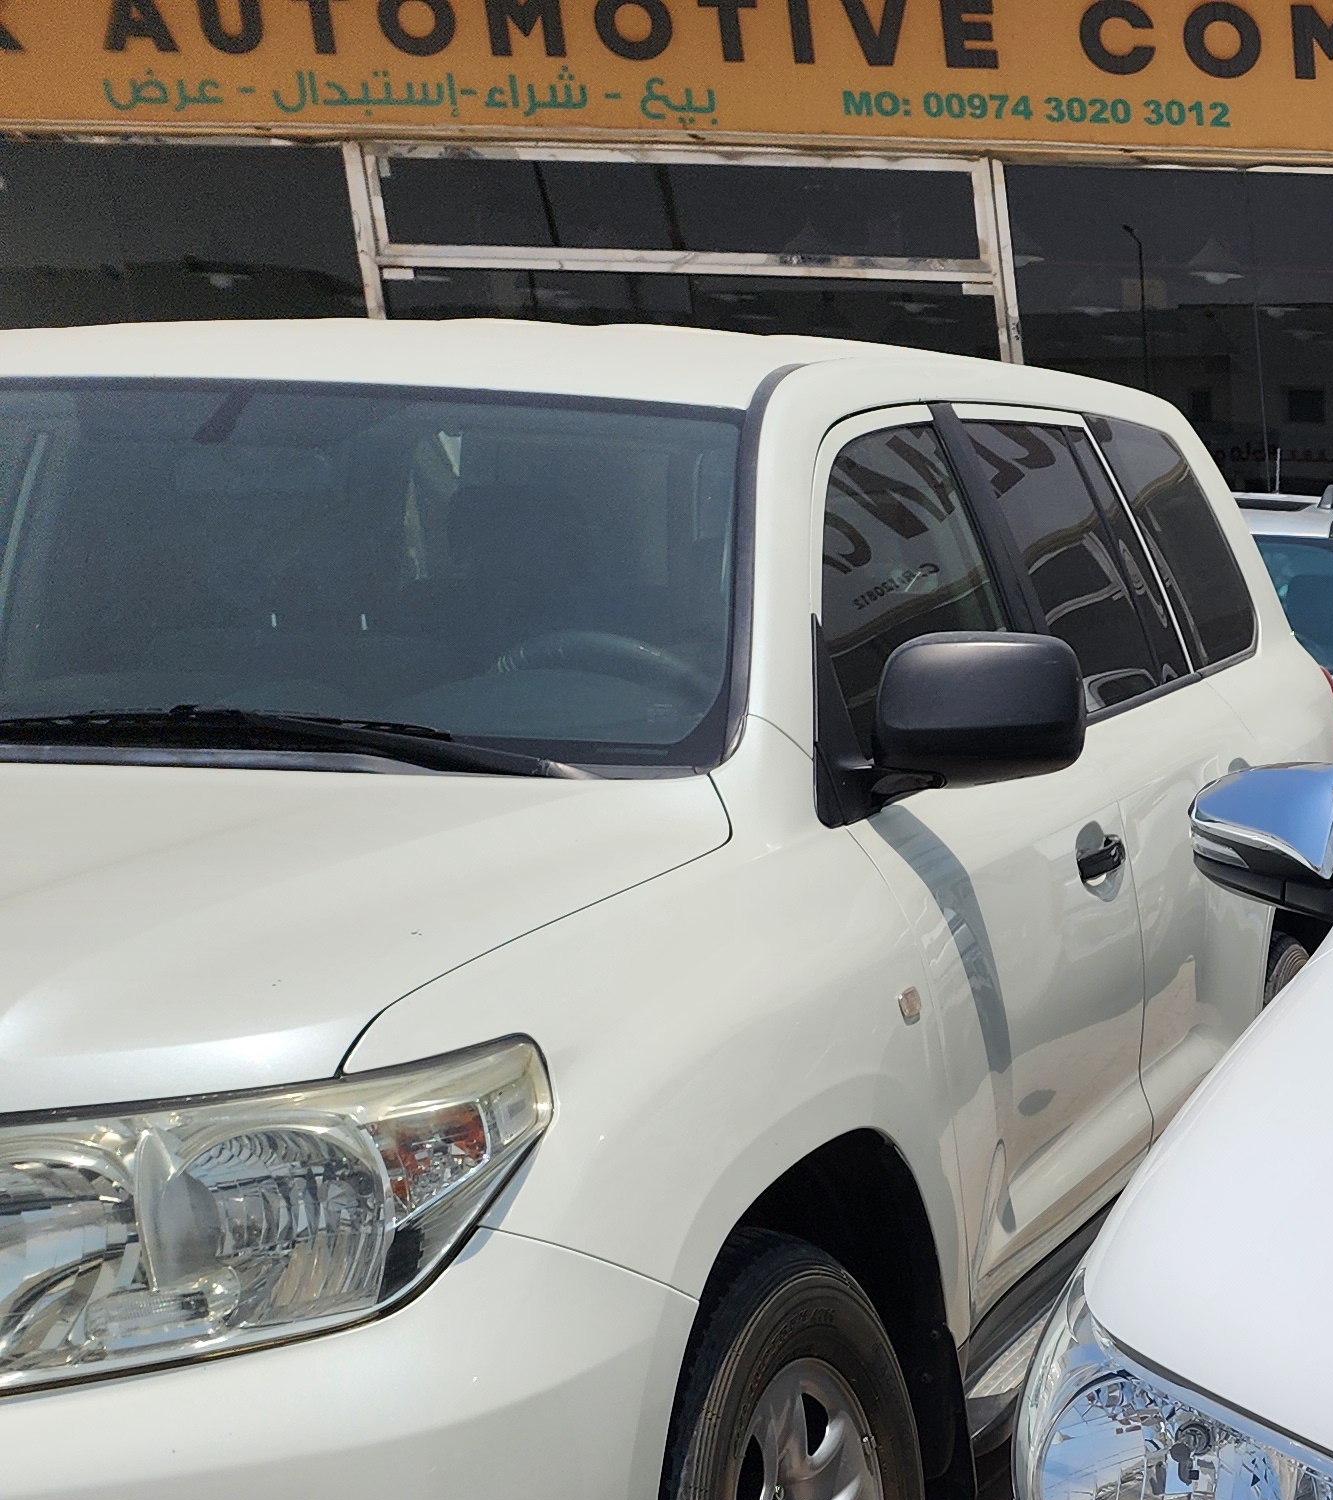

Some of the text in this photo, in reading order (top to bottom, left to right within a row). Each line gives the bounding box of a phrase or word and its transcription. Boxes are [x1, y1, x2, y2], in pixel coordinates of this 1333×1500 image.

[103, 0, 999, 70] AUTOMOTIVE
[103, 69, 224, 112] عرض
[640, 78, 717, 121] بيع
[843, 91, 1230, 128] MO: 00974 3020 3012
